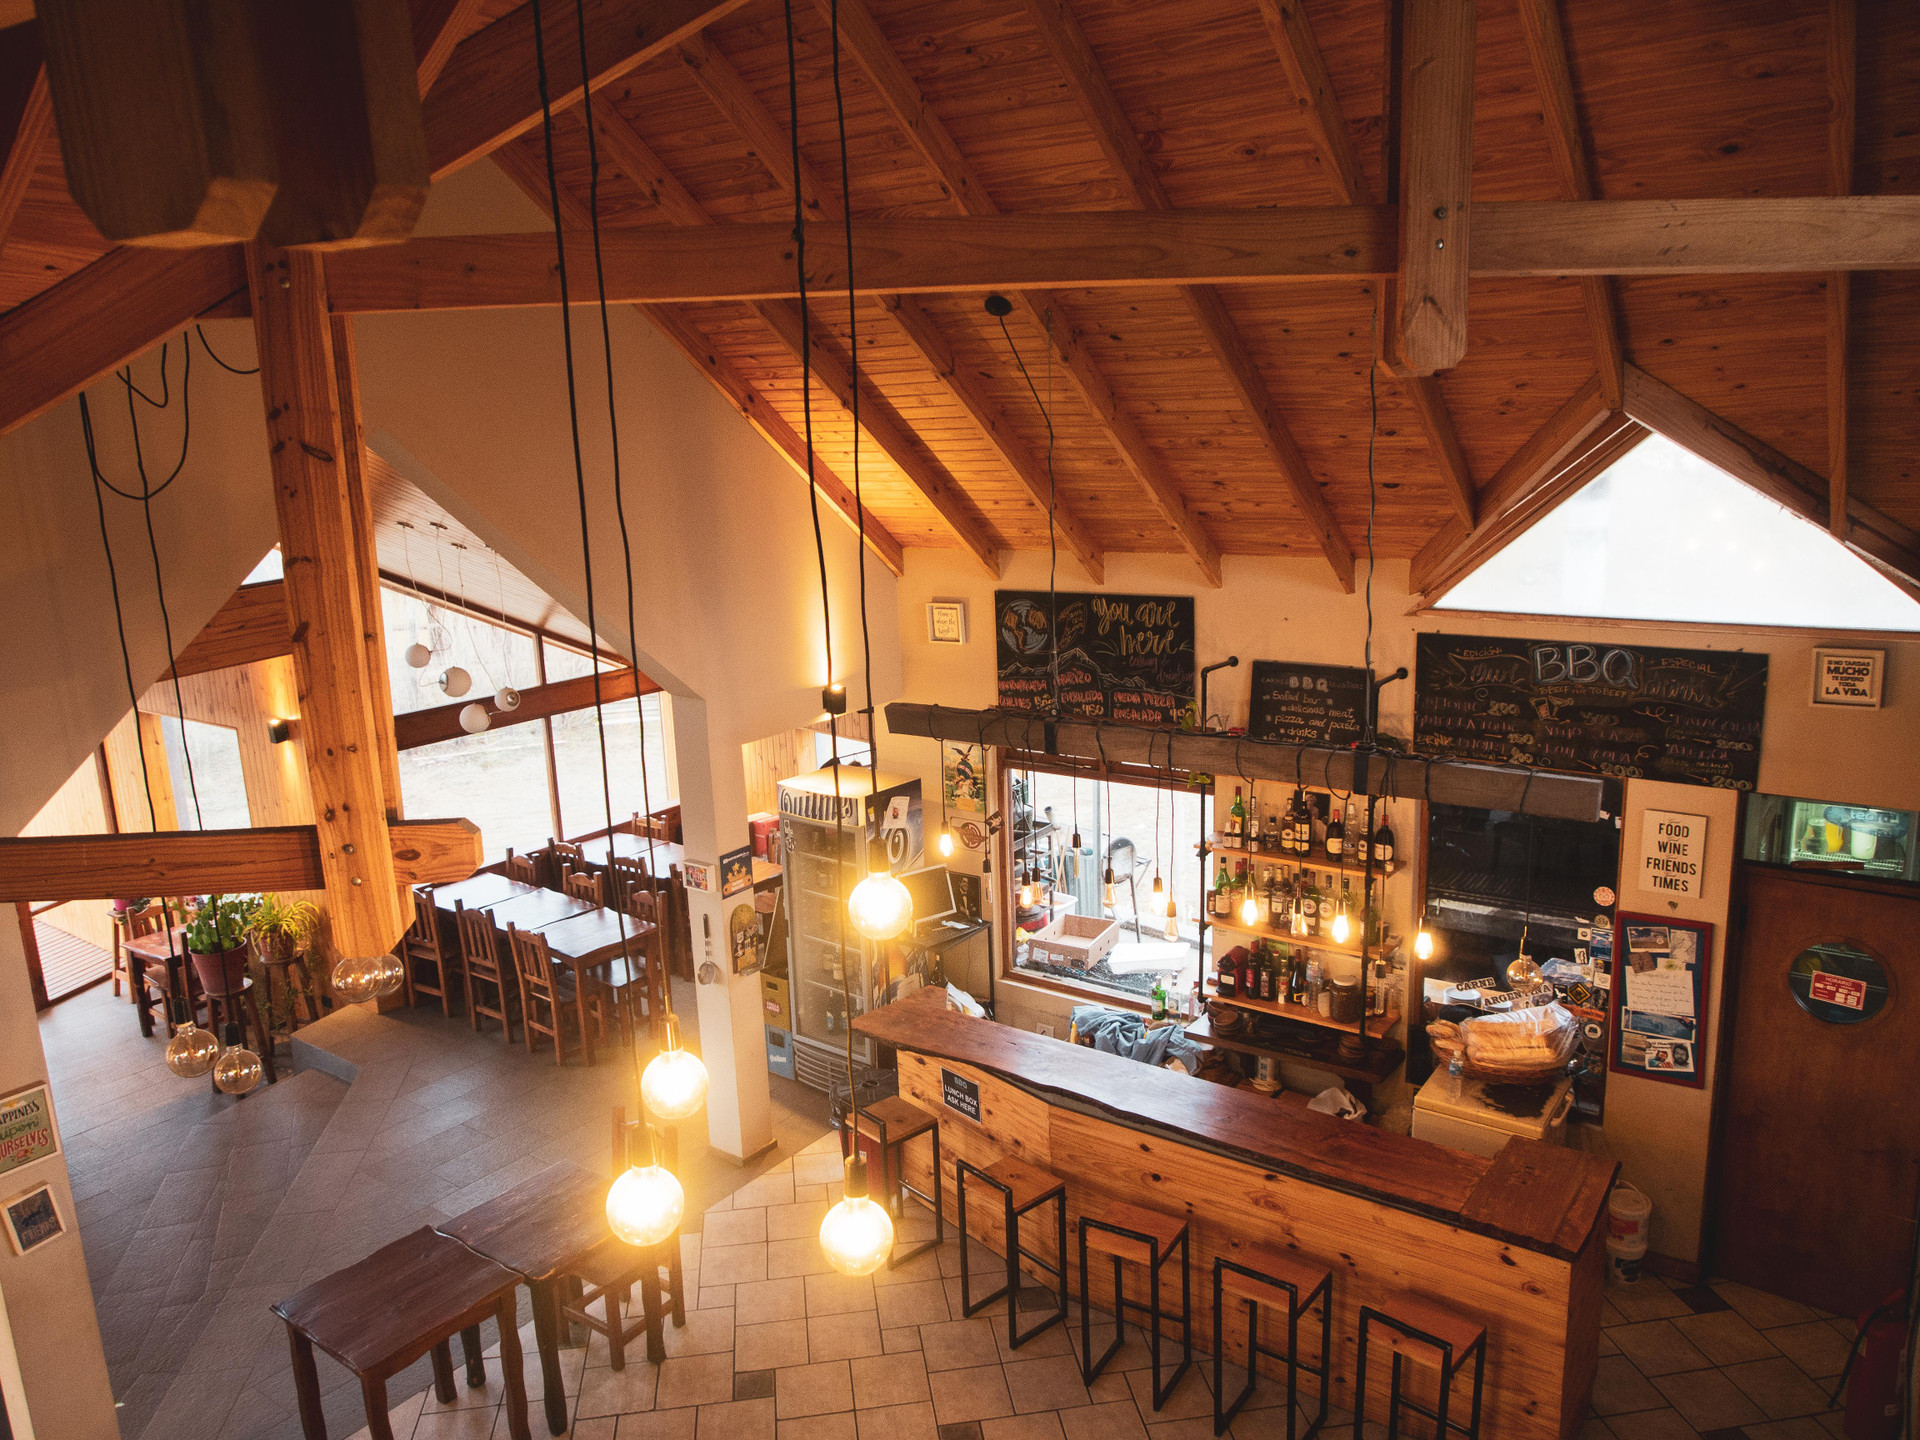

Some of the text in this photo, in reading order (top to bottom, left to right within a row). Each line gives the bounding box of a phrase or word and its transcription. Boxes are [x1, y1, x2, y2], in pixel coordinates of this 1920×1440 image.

[1136, 601, 1180, 628] are
[1120, 624, 1178, 656] here
[1534, 645, 1639, 690] BBQ
[1827, 666, 1870, 677] MUCHO
[1289, 676, 1329, 693] BBQ
[1826, 687, 1868, 697] LA VIDA
[1272, 690, 1320, 704] Salad bar
[1113, 708, 1162, 723] ENSALADA
[1287, 704, 1355, 719] delicious meat
[1275, 714, 1360, 733] pizza and pasta
[1287, 728, 1318, 739] drinks
[1659, 823, 1689, 838] FOOD
[1658, 841, 1689, 856] WINE
[1646, 857, 1696, 875] FRIENDS
[1652, 876, 1689, 892] TIMES
[1456, 978, 1494, 991] CARNE
[1825, 977, 1852, 987] HORARIO
[944, 1084, 978, 1107] LUNCH BOX
[947, 1095, 976, 1115] ASK HERE
[0, 1128, 49, 1161] URSELVES
